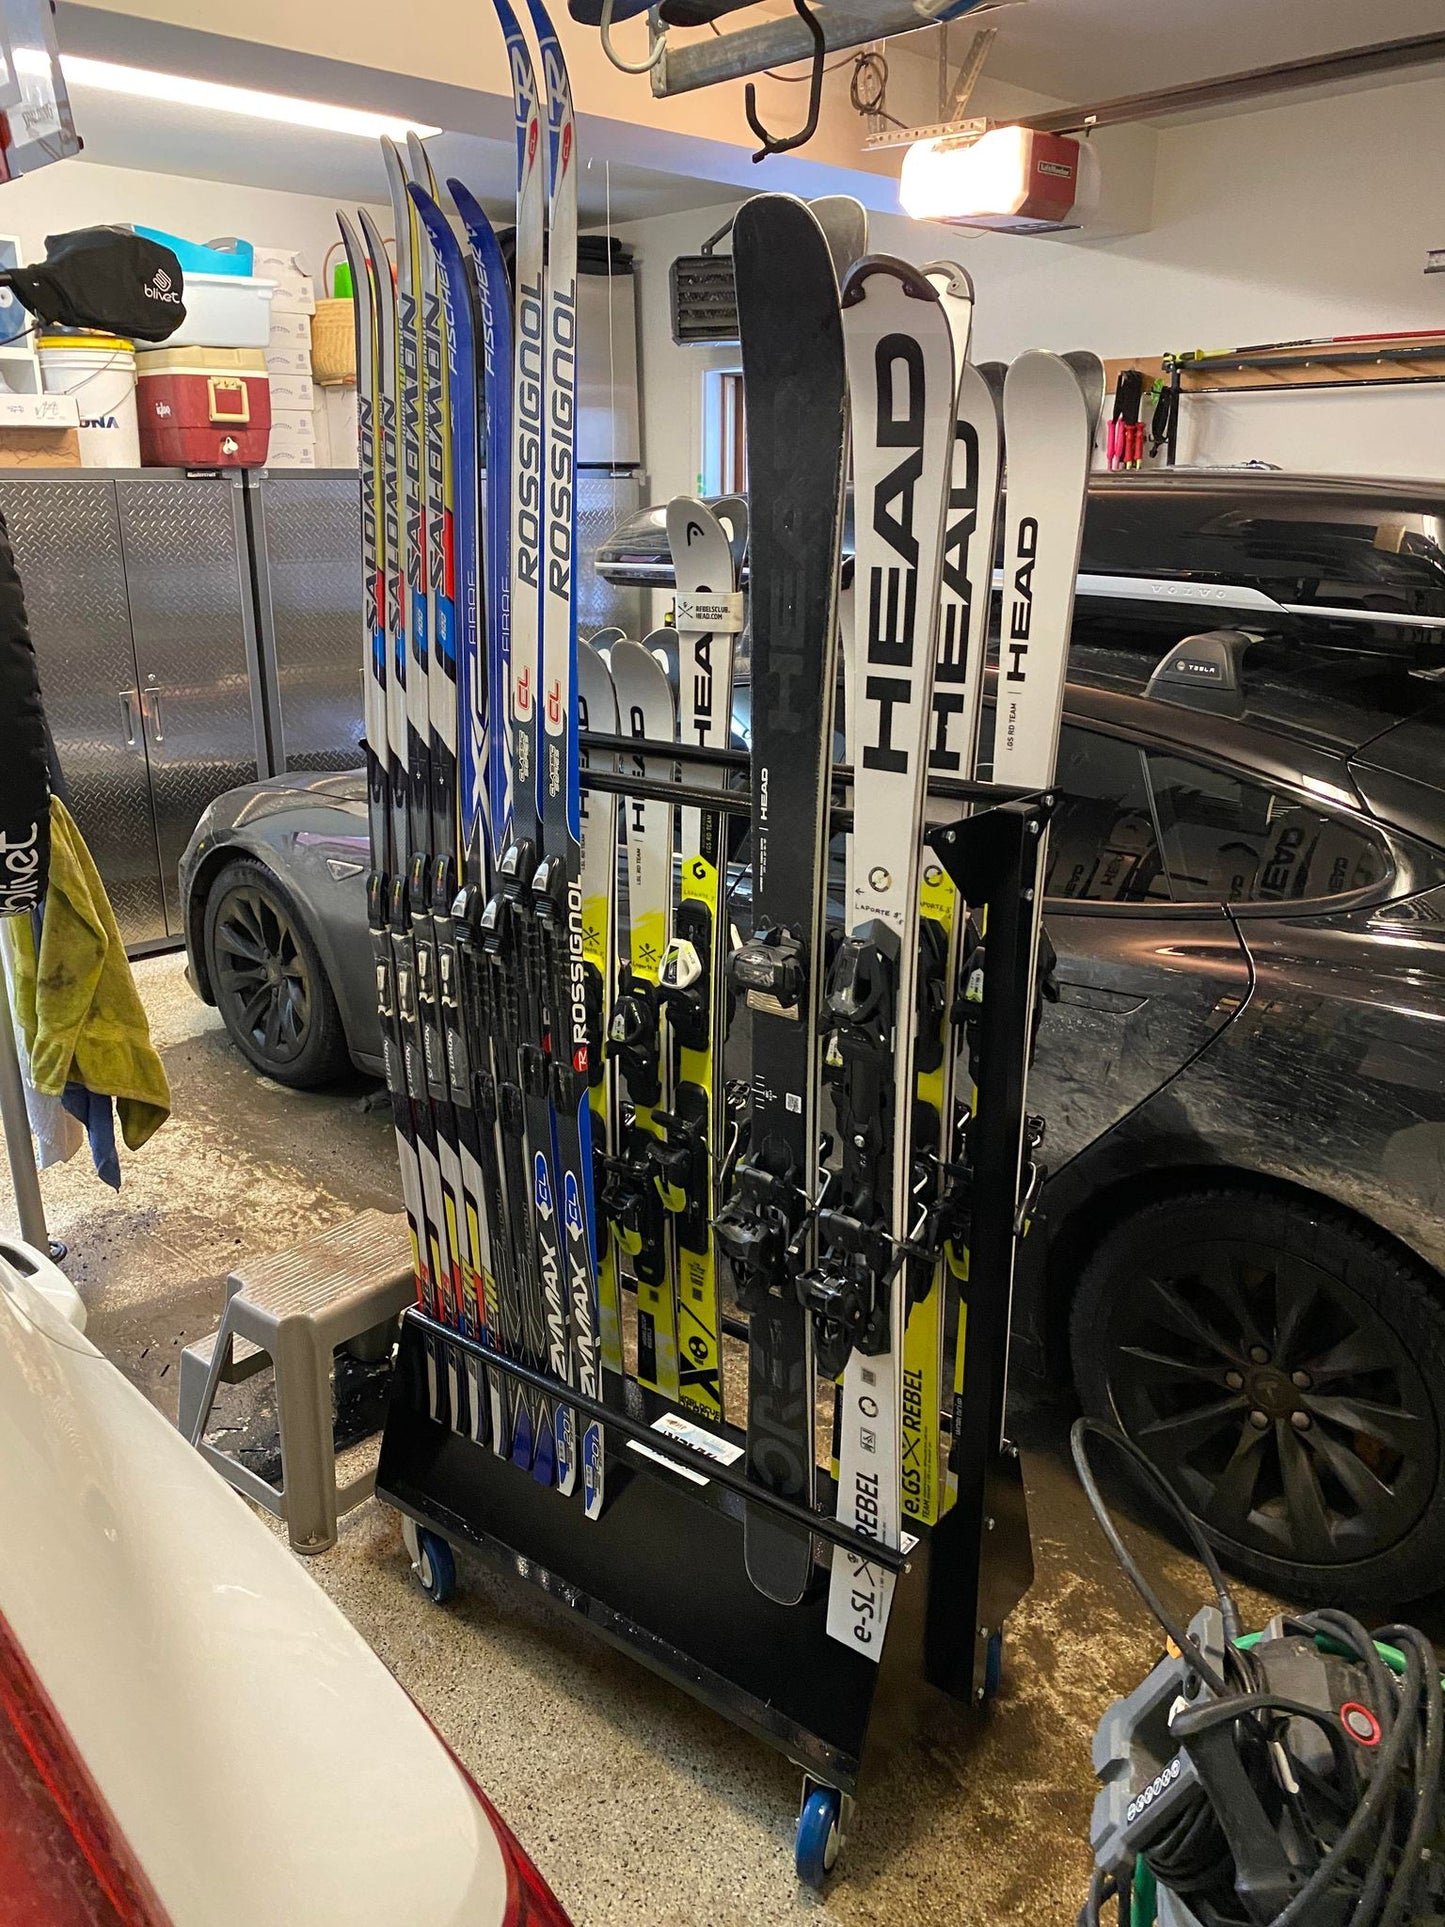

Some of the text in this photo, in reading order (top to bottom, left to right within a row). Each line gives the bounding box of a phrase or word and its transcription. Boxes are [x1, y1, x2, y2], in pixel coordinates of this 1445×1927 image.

[144, 283, 181, 304] blivet
[433, 247, 458, 376] FISCHER
[472, 244, 495, 377] FISCHER
[401, 291, 422, 596] SALOMON
[425, 291, 446, 598] SALOMON
[517, 271, 541, 589] ROSSIGNOL
[550, 279, 575, 600] ROSSIGNOL
[361, 396, 378, 637] SALOMON
[383, 396, 401, 639] SALOMON
[863, 333, 926, 774] HEAD
[928, 420, 980, 771] HEAD
[1006, 516, 1039, 682] HEAD
[517, 665, 530, 711] CL
[548, 679, 561, 725] CL
[1188, 664, 1216, 673] TESLA
[760, 768, 769, 821] HEAD
[568, 874, 588, 1044] ROSSIGNOL
[855, 903, 890, 917] LAPORTE
[538, 1173, 547, 1201] CL
[569, 1193, 577, 1221] CL
[540, 1232, 567, 1382] ZYMAX
[570, 1252, 597, 1400] ZYMAX
[902, 1369, 923, 1433] REBEL
[856, 1472, 879, 1543] REBEL
[902, 1467, 921, 1515] e.GS
[922, 1502, 931, 1519] TEAM
[851, 1591, 875, 1644] e-SL
